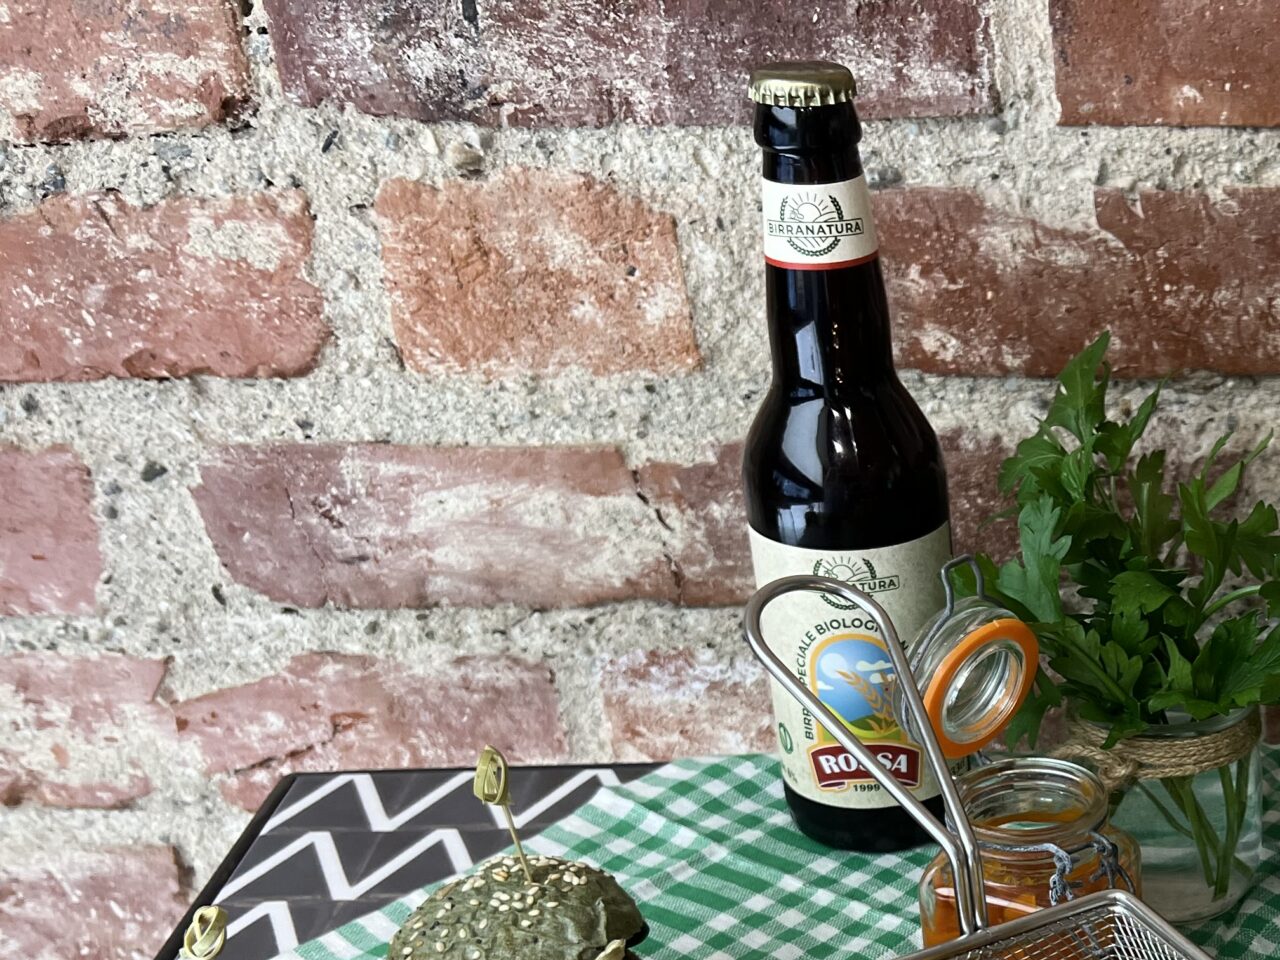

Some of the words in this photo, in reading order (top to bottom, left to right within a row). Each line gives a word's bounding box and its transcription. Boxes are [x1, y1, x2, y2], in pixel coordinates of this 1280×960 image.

[767, 220, 862, 236] BIRRANATURA
[814, 618, 878, 635] BIOLOG
[796, 631, 816, 688] PECIALE
[802, 707, 815, 740] BIRR
[818, 752, 908, 775] ROSA
[852, 783, 881, 793] 1999
